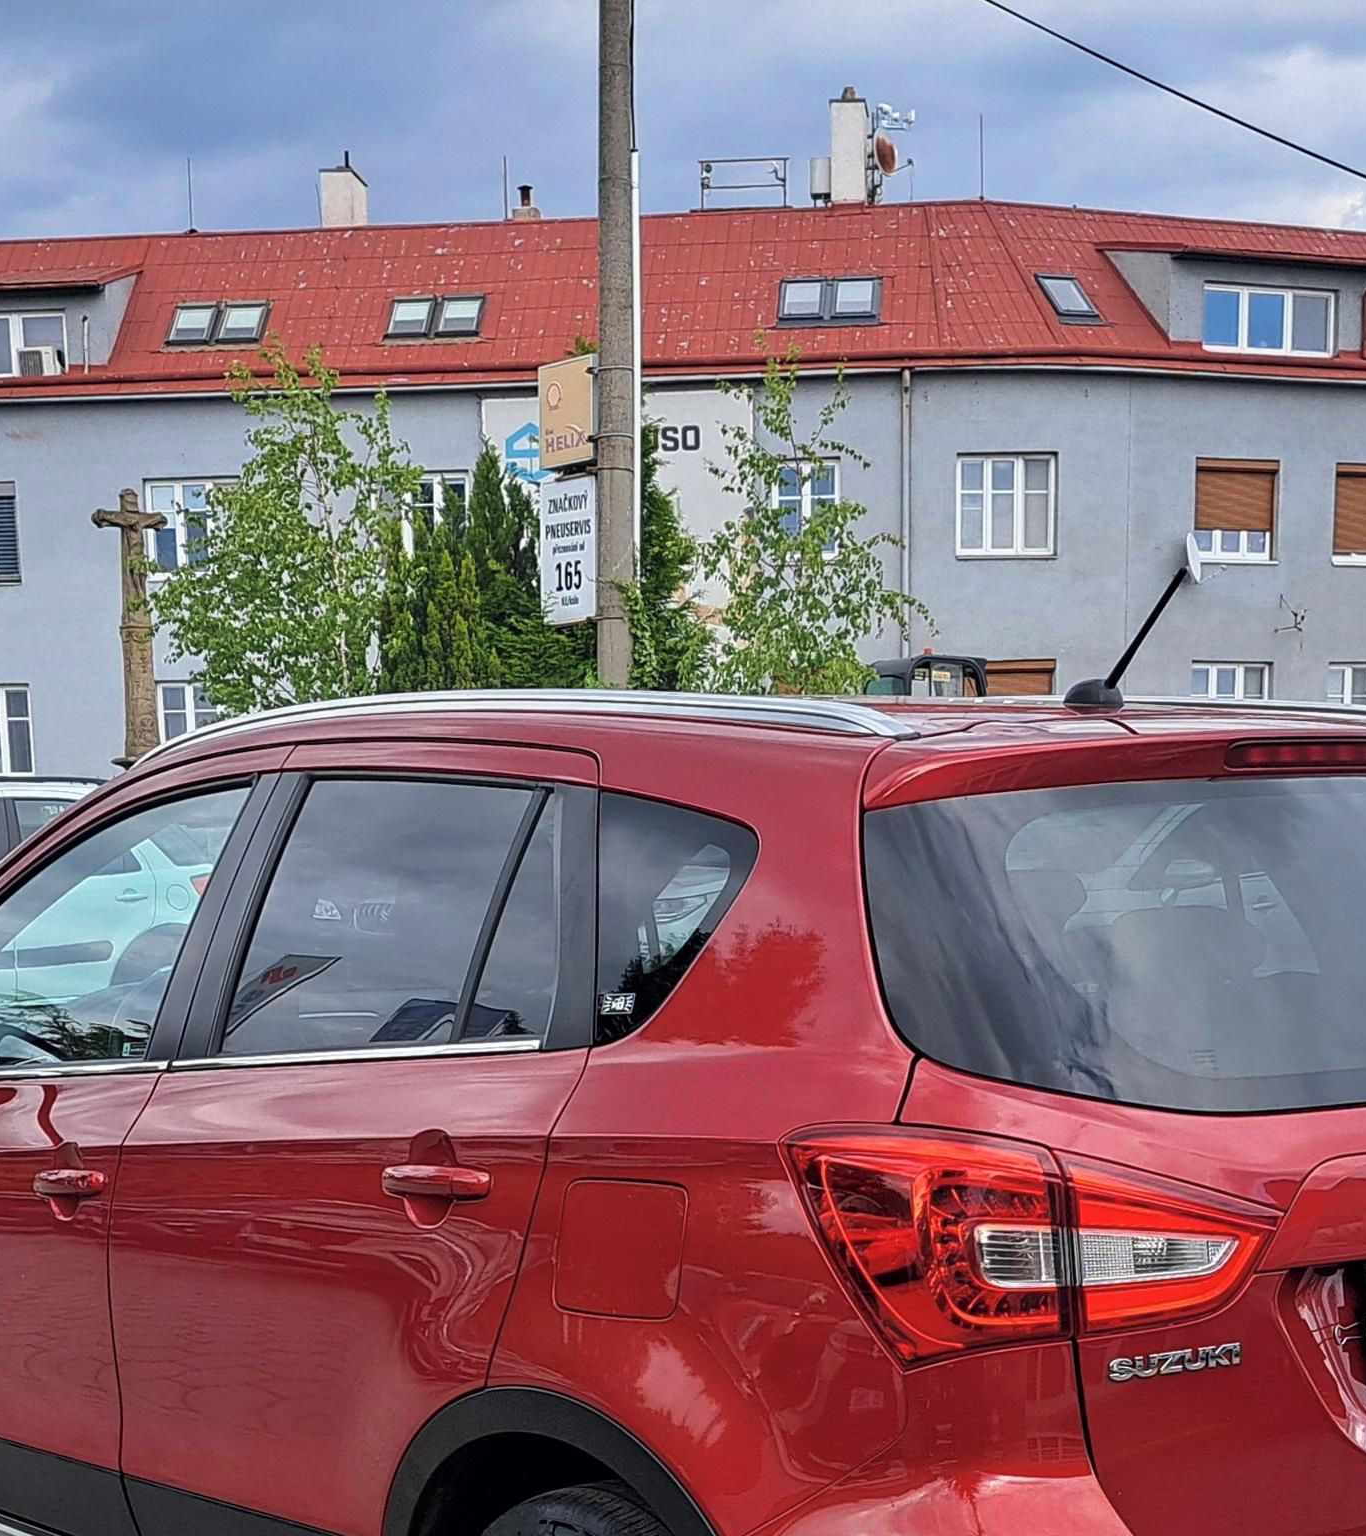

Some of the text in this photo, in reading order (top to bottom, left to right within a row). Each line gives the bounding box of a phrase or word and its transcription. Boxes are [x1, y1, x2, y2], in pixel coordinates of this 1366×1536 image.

[545, 430, 587, 453] HELIX
[548, 490, 589, 514] ZNAČKOVÝ
[545, 519, 591, 540] PNEUSERVIS
[555, 560, 582, 592] 165
[1109, 1342, 1241, 1382] SUZUKI
